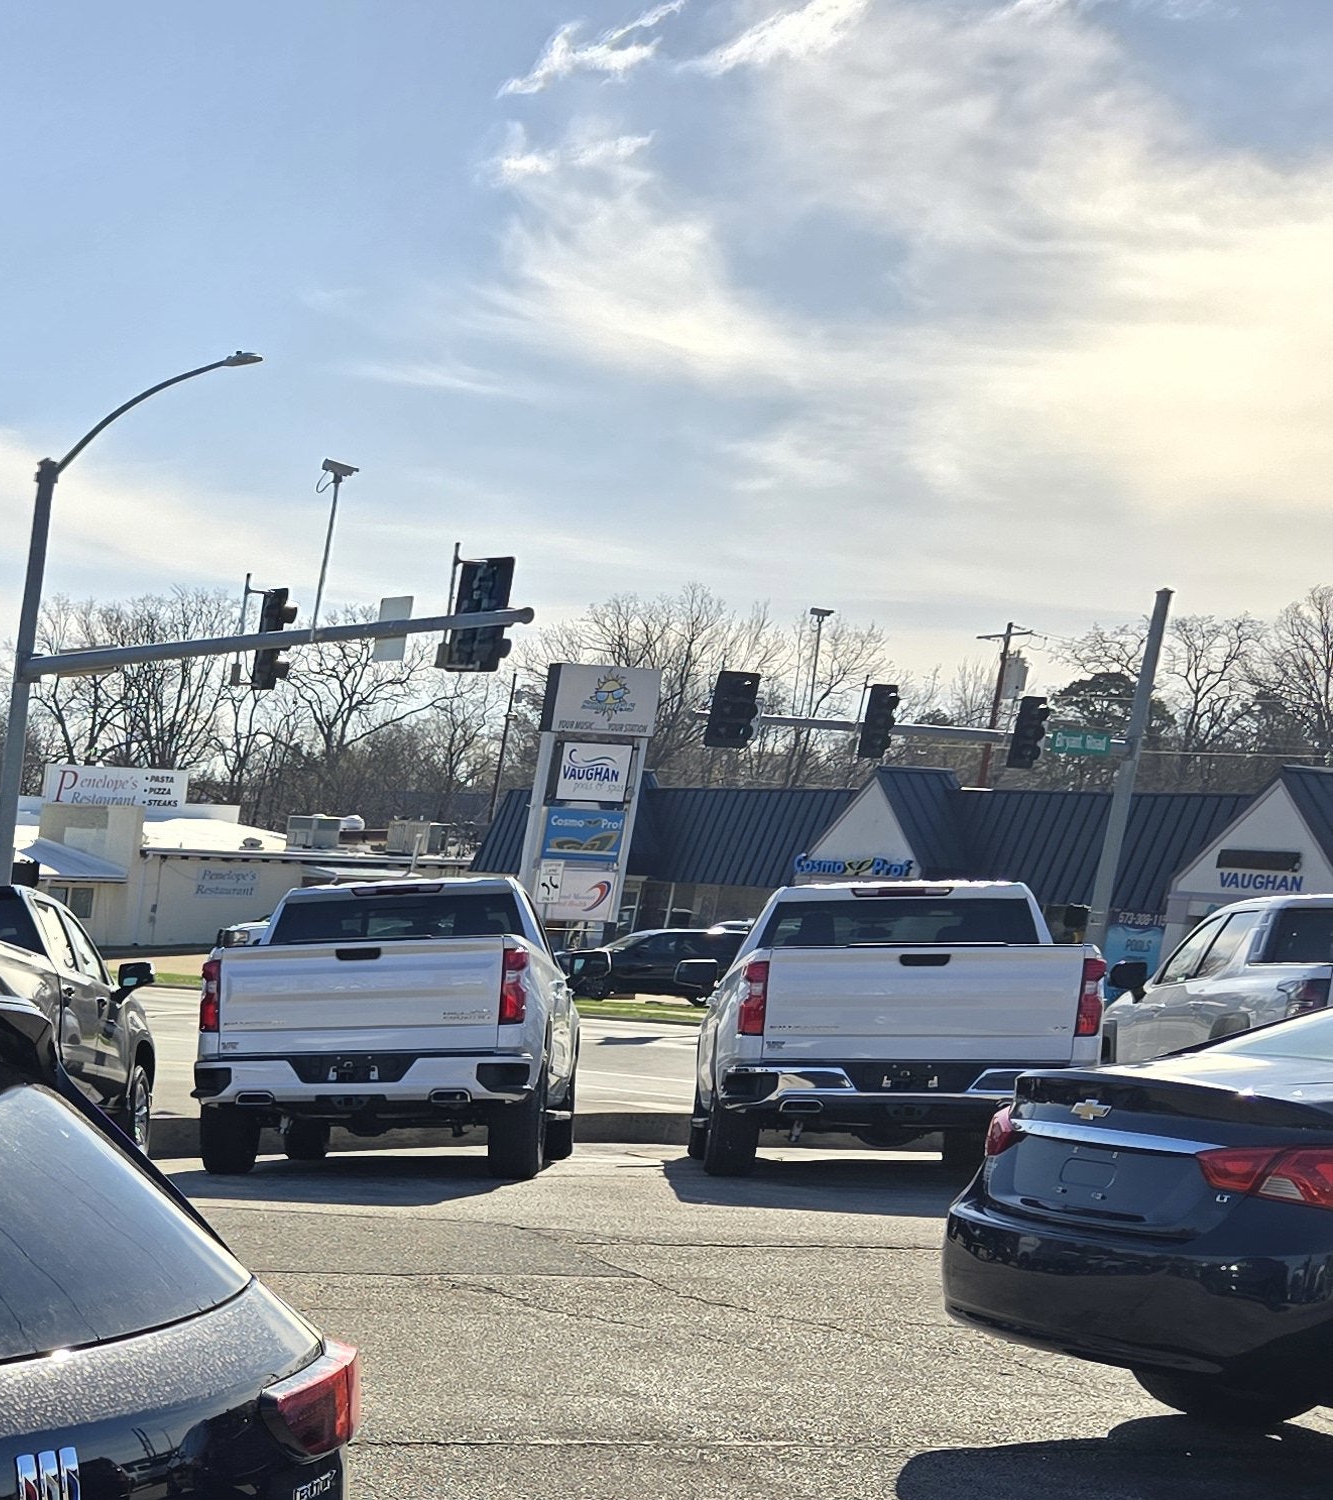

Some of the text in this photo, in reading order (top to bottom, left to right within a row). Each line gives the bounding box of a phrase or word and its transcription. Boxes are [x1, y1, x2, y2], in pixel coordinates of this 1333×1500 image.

[558, 719, 574, 729] YOUR
[608, 723, 624, 732] YOUR
[624, 723, 649, 734] STATION
[1055, 731, 1107, 751] Bryant Road
[149, 775, 175, 784] PASTA
[563, 765, 620, 782] VAUGHAN
[51, 769, 139, 803] Penelope's
[148, 787, 172, 796] PIZZA
[71, 791, 137, 806] Restaurant
[147, 799, 179, 808] STEAKS
[550, 815, 624, 830] Cosmo Prof
[794, 852, 914, 877] Cosmo Prof
[201, 869, 257, 883] Penelope's
[1219, 871, 1304, 892] VAUGHAN
[195, 884, 254, 896] Restaurant
[1125, 938, 1153, 952] POOLS
[1215, 1194, 1231, 1203] LT
